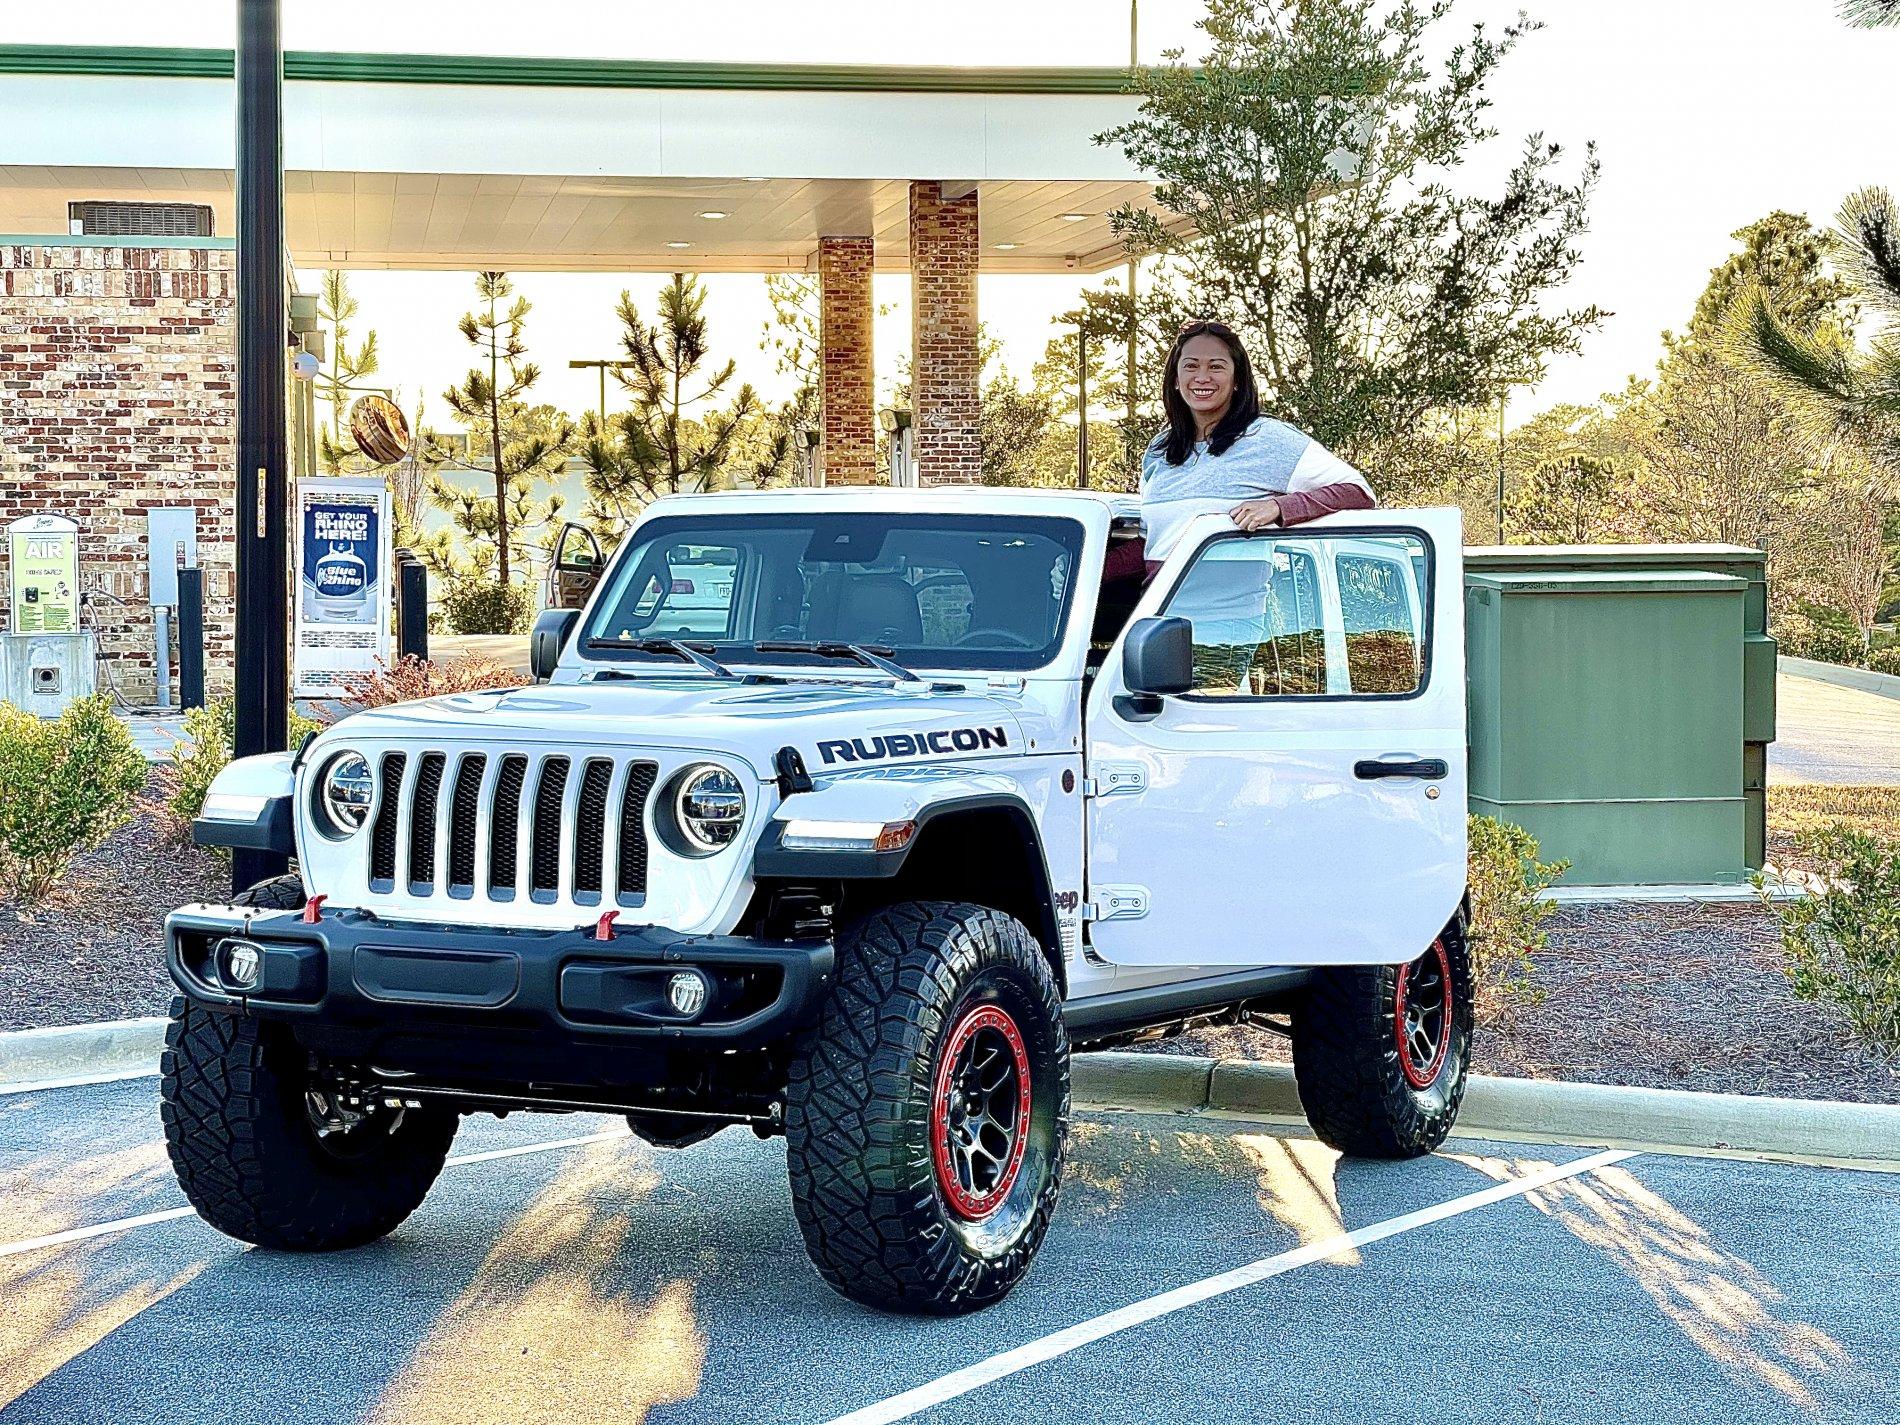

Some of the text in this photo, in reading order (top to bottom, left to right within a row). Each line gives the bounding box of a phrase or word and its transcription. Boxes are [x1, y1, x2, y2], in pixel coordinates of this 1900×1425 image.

[315, 511, 368, 520] GET YOUR
[315, 519, 368, 530] RHINO
[315, 529, 368, 541] HERE!
[25, 541, 64, 559] AIR
[327, 566, 357, 576] Blue
[323, 574, 362, 586] Rhino
[816, 726, 1008, 764] RUBICON
[1054, 890, 1078, 914] eep
